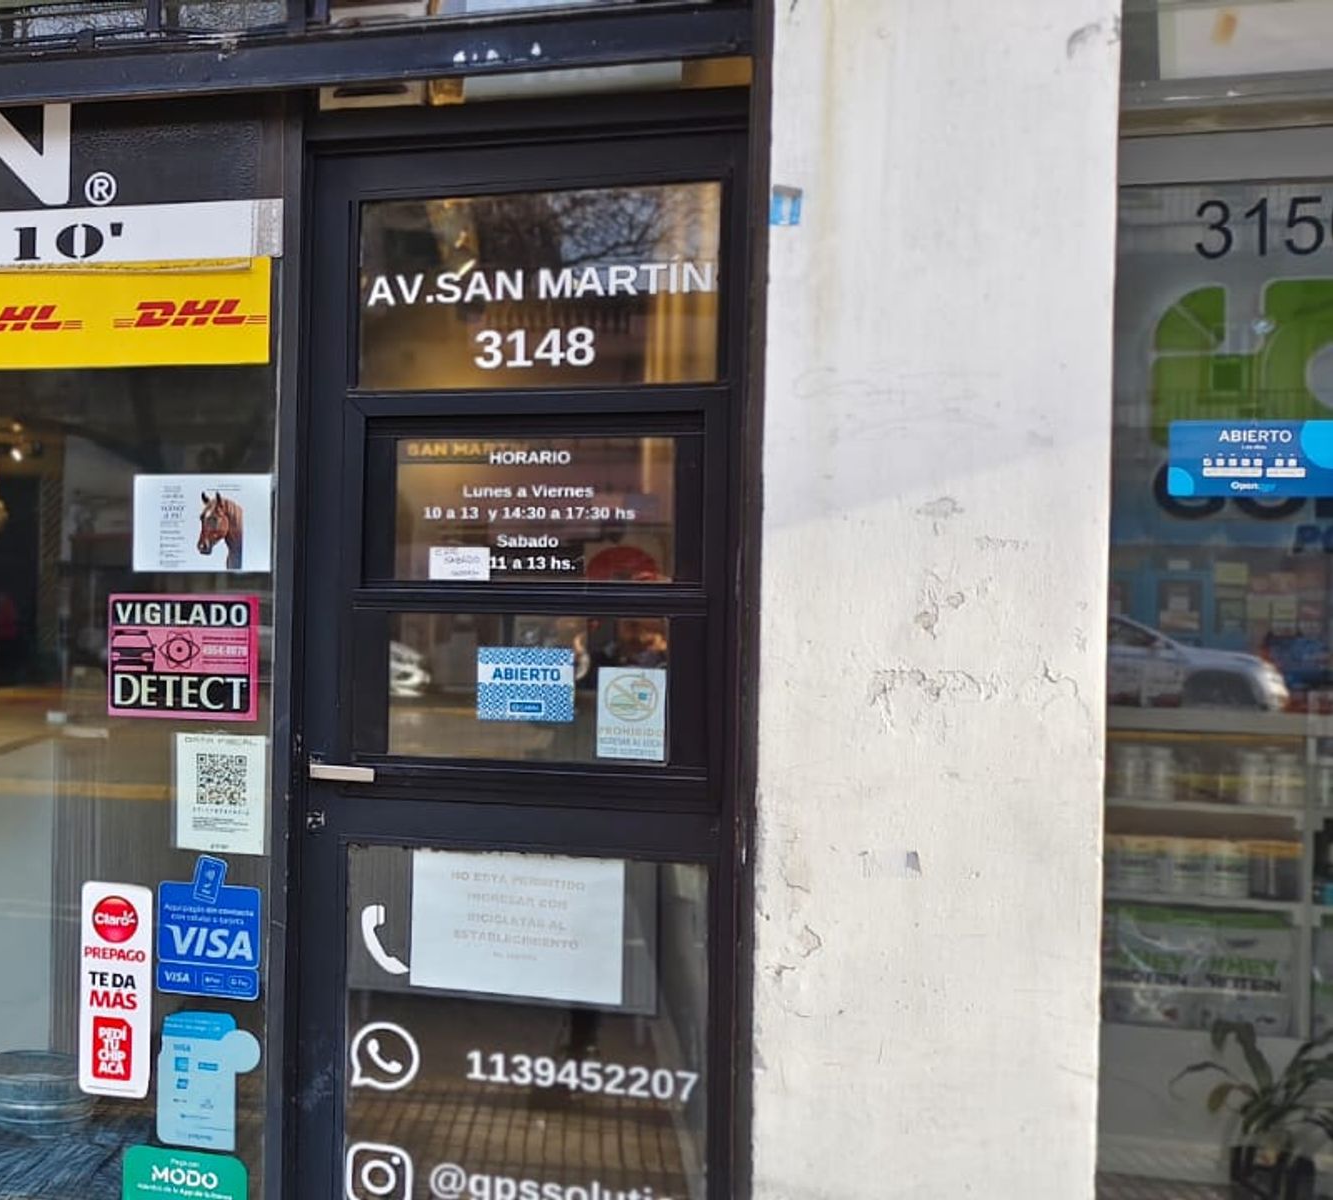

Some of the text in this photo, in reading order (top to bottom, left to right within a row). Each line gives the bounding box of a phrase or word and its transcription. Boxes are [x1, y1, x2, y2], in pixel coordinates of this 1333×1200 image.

[1194, 195, 1333, 260] 315
[367, 265, 524, 307] AV.SAN
[134, 298, 248, 329] DHL
[473, 326, 597, 369] 3148
[1218, 429, 1293, 443] ABIERTO
[489, 451, 571, 465] HORARIO
[462, 484, 595, 499] Lunes a Viernes
[424, 506, 636, 522] 10 a 13 y 14:30 a 17:30 hs
[496, 533, 559, 548] Sabado
[512, 559, 523, 570] a
[527, 556, 546, 570] 13
[550, 556, 576, 570] hs.
[115, 602, 248, 626] VIGILADO
[492, 666, 561, 682] ABIERTO
[114, 673, 247, 710] DETECT
[95, 910, 131, 927] Claro
[165, 924, 253, 961] VISA
[84, 946, 146, 963] PREPAGO
[88, 971, 137, 990] TE DA
[164, 970, 191, 983] VISA
[103, 1039, 121, 1050] TU
[97, 1048, 127, 1061] CHIP
[466, 1050, 699, 1102] 1139452207
[151, 1165, 218, 1190] MODO
